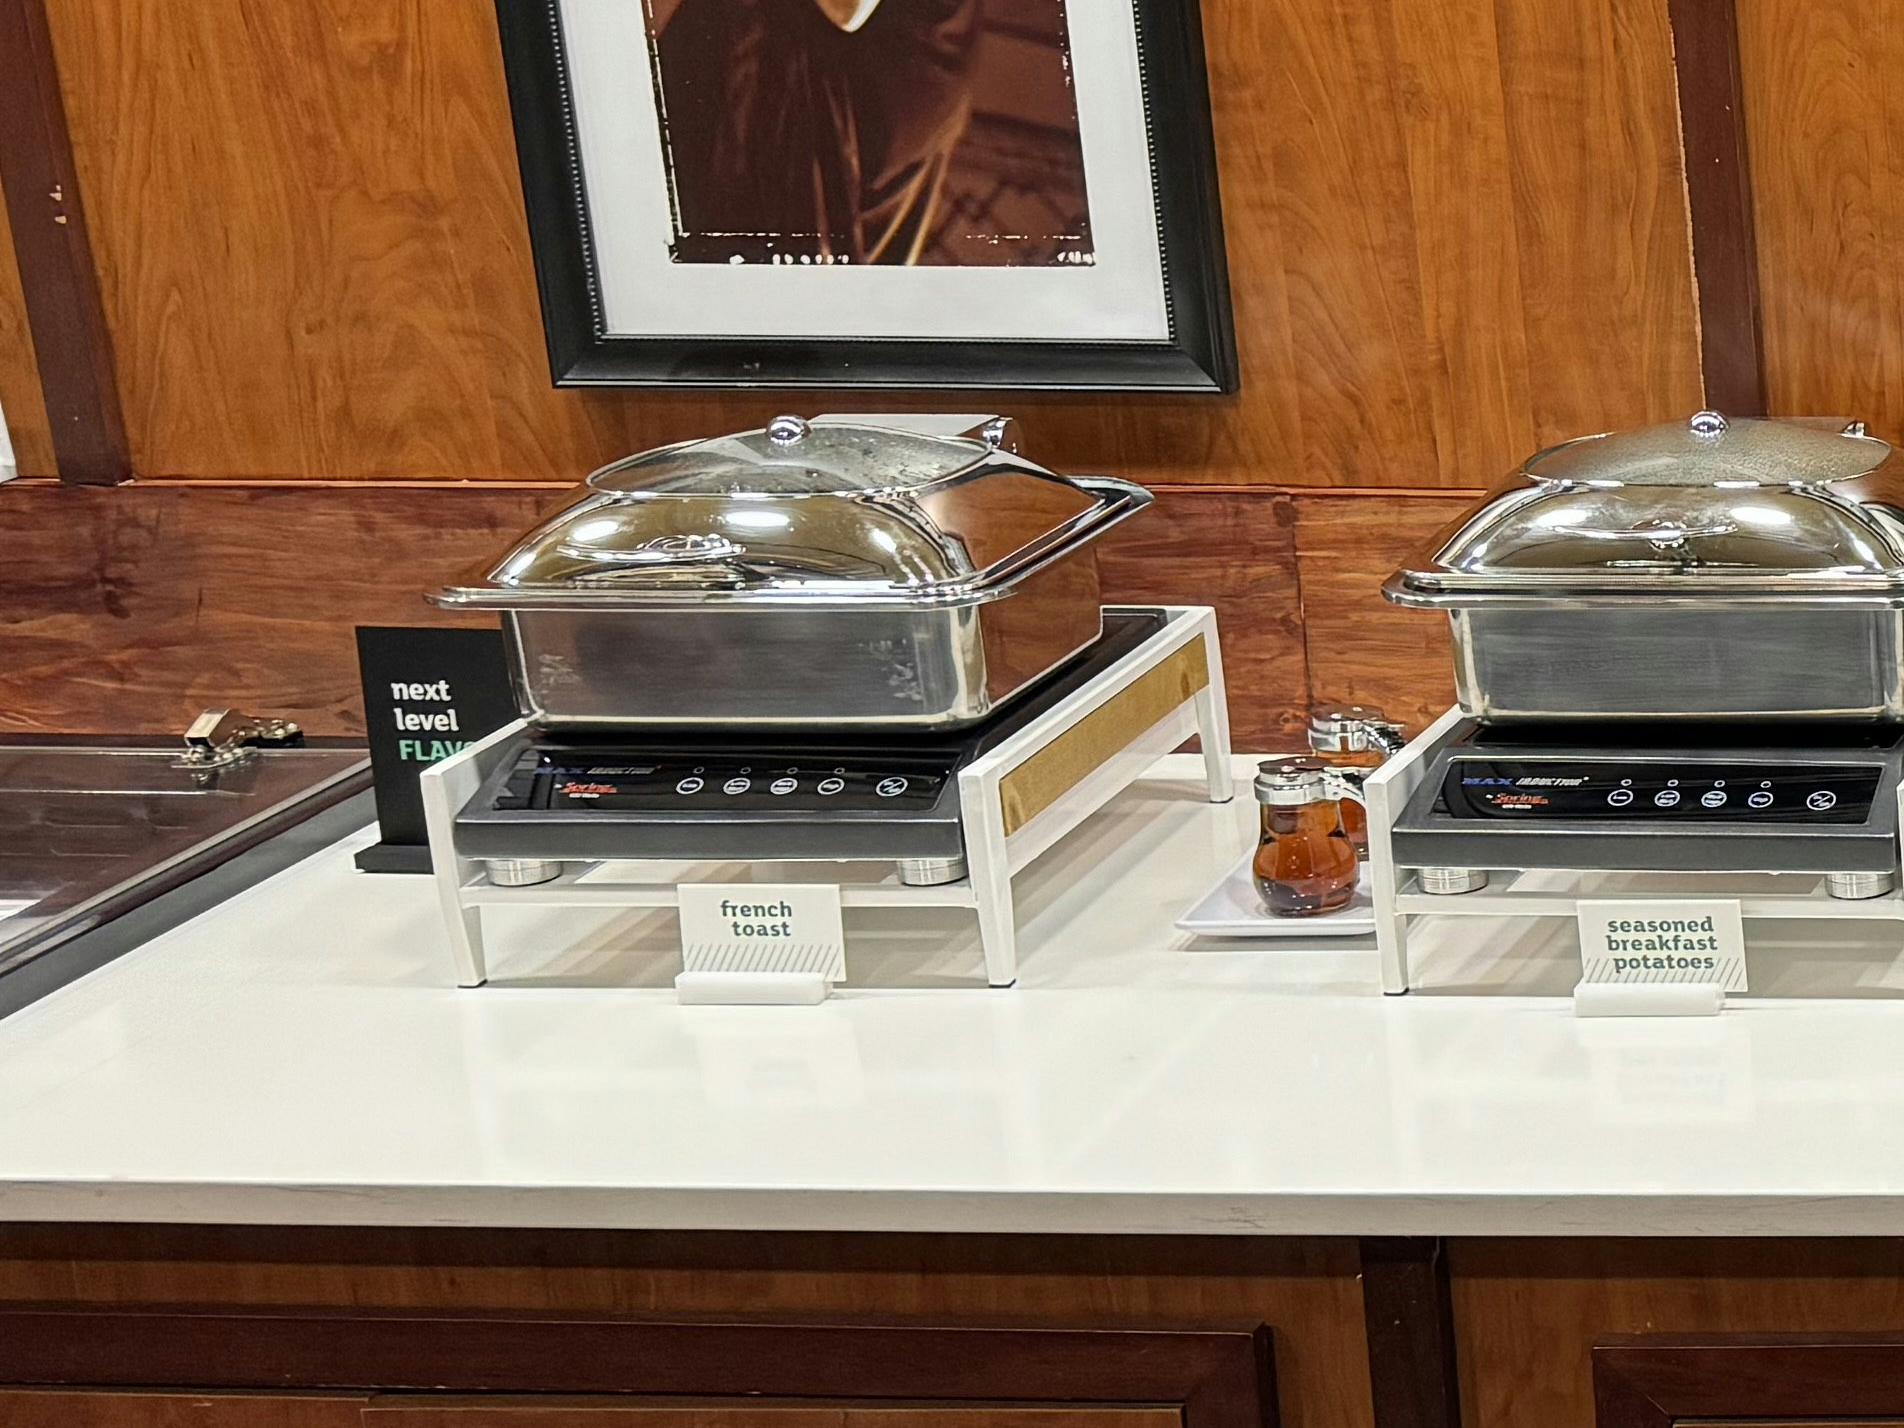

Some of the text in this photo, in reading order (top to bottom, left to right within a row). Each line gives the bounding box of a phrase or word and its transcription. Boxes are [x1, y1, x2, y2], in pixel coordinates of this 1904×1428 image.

[390, 679, 452, 702] next
[393, 707, 460, 732] level
[399, 739, 475, 761] FLAV
[720, 899, 793, 918] french
[731, 921, 791, 937] toast
[1607, 915, 1715, 933] seasoned
[1605, 934, 1718, 951] breakfast
[1612, 954, 1715, 974] potatoes
